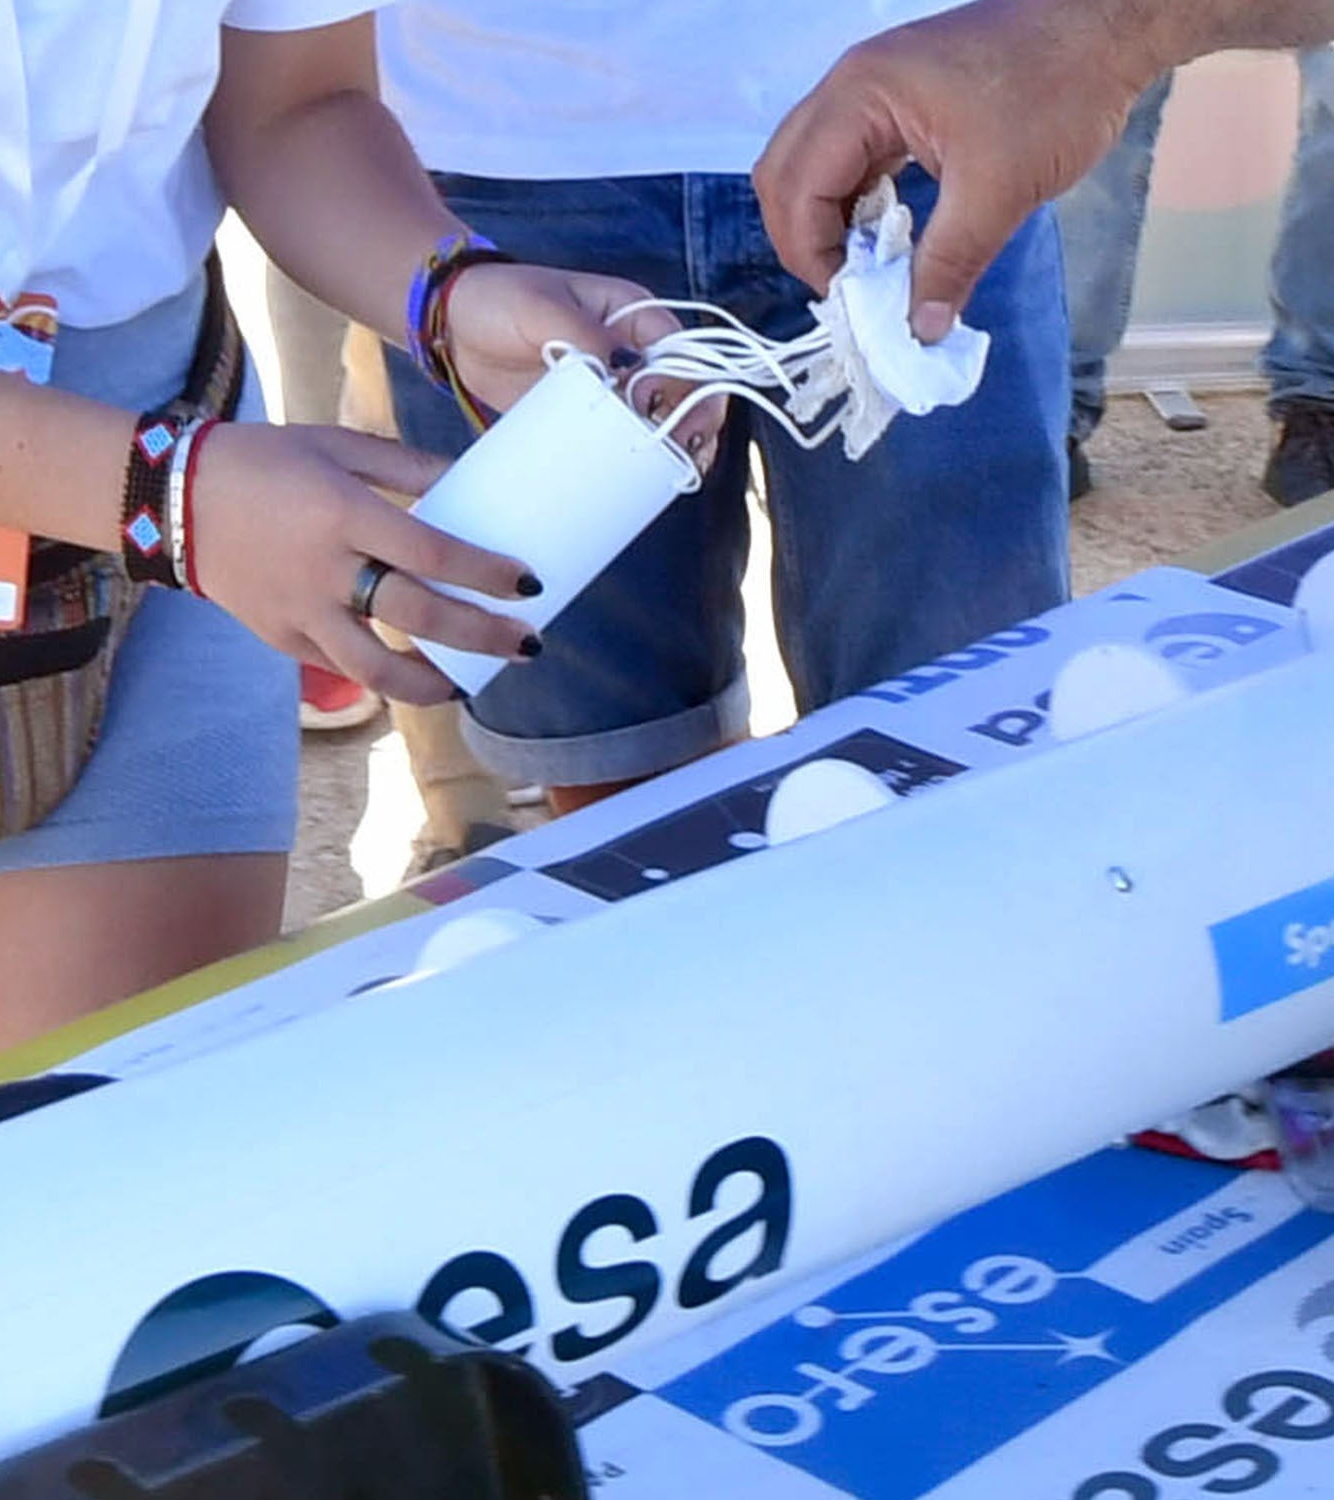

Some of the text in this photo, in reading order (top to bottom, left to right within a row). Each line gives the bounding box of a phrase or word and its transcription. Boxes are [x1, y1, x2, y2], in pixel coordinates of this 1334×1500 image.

[415, 1135, 791, 1363] esa
[1161, 1205, 1255, 1258] Spain
[723, 1253, 1058, 1447] esero
